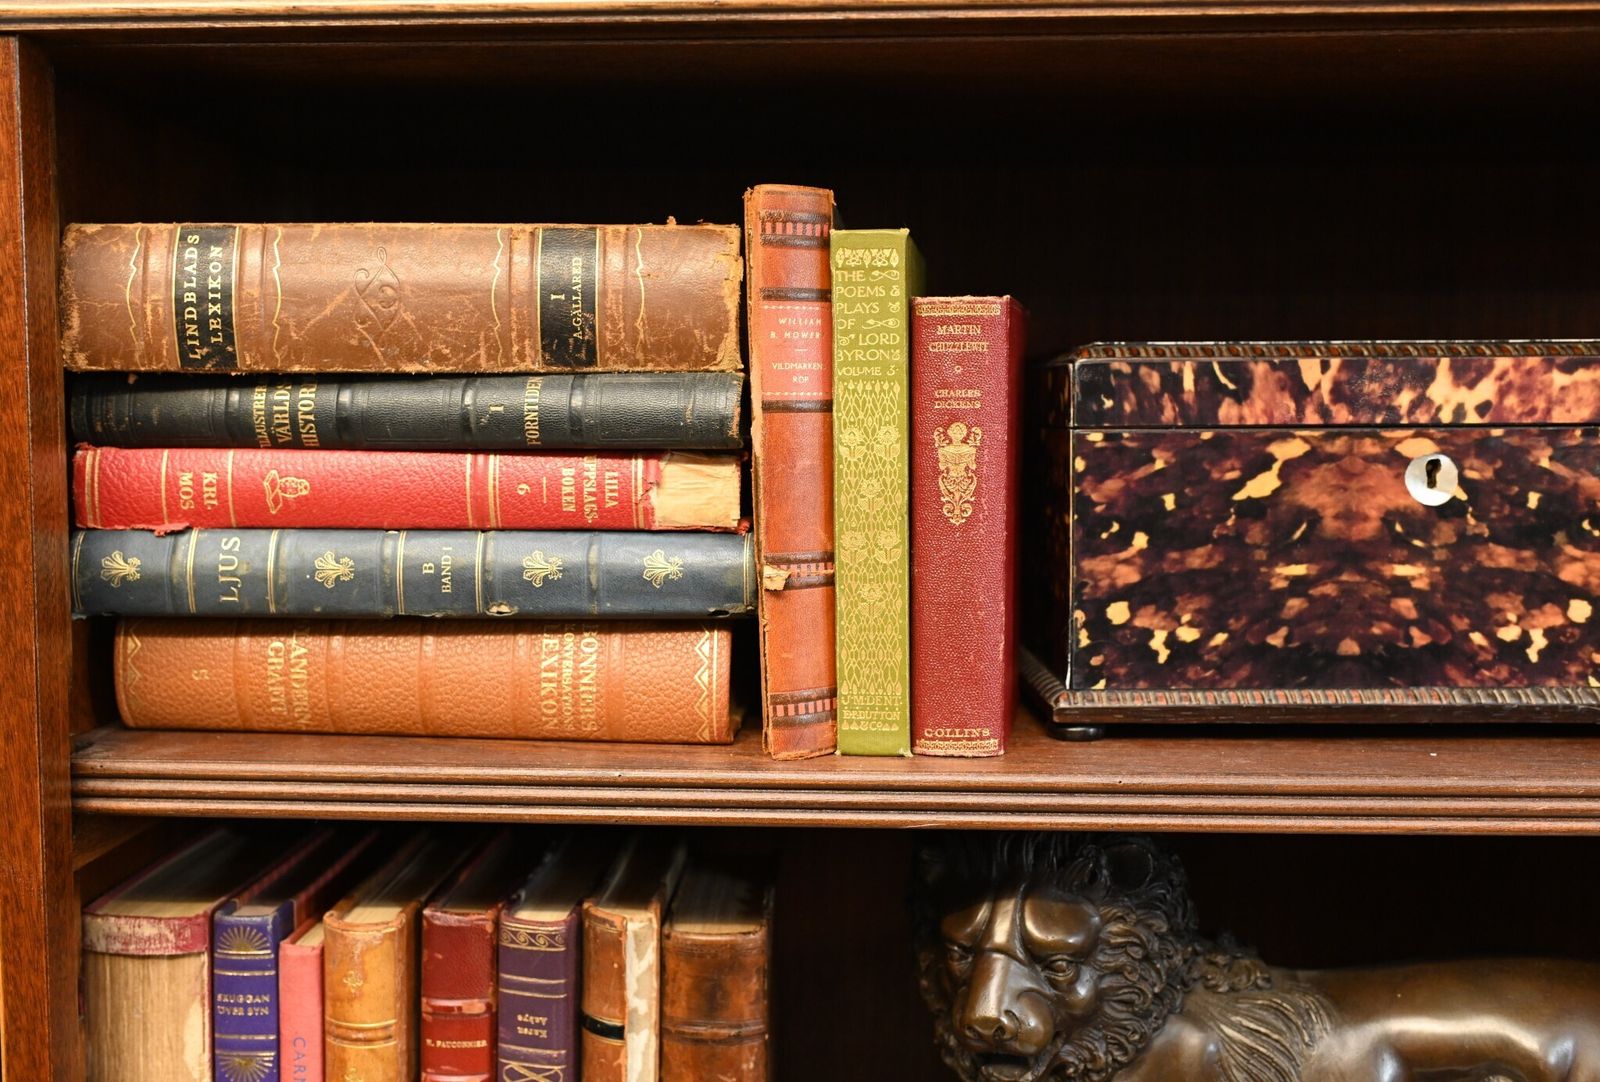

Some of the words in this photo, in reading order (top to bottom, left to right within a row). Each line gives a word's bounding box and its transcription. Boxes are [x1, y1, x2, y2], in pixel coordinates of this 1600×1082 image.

[836, 270, 865, 281] THE
[184, 234, 201, 360] LINDBLADS
[208, 245, 223, 344] LEXIKON
[836, 286, 886, 297] POEMS
[836, 302, 880, 314] PLAYS
[778, 318, 822, 326] WILLIAM
[837, 319, 856, 330] OF
[784, 331, 821, 339] MOWER
[936, 325, 981, 335] MARTIN
[858, 333, 900, 345] LORD
[836, 349, 890, 361] BYRON
[837, 366, 882, 377] VOLUME
[792, 375, 809, 383] ROP
[935, 389, 981, 397] CHARLES
[934, 400, 981, 408] DICKENS
[524, 376, 544, 446] FORNTIDEN
[180, 471, 195, 510] MOS
[517, 483, 531, 495] 6
[561, 467, 576, 512] BOKEN
[605, 470, 619, 508] LILLA
[218, 536, 242, 603] LJUS
[422, 562, 435, 574] B
[441, 555, 452, 593] BAND
[192, 669, 210, 681] 5
[541, 625, 560, 731] LEXIKON
[924, 728, 991, 738] COLLINS
